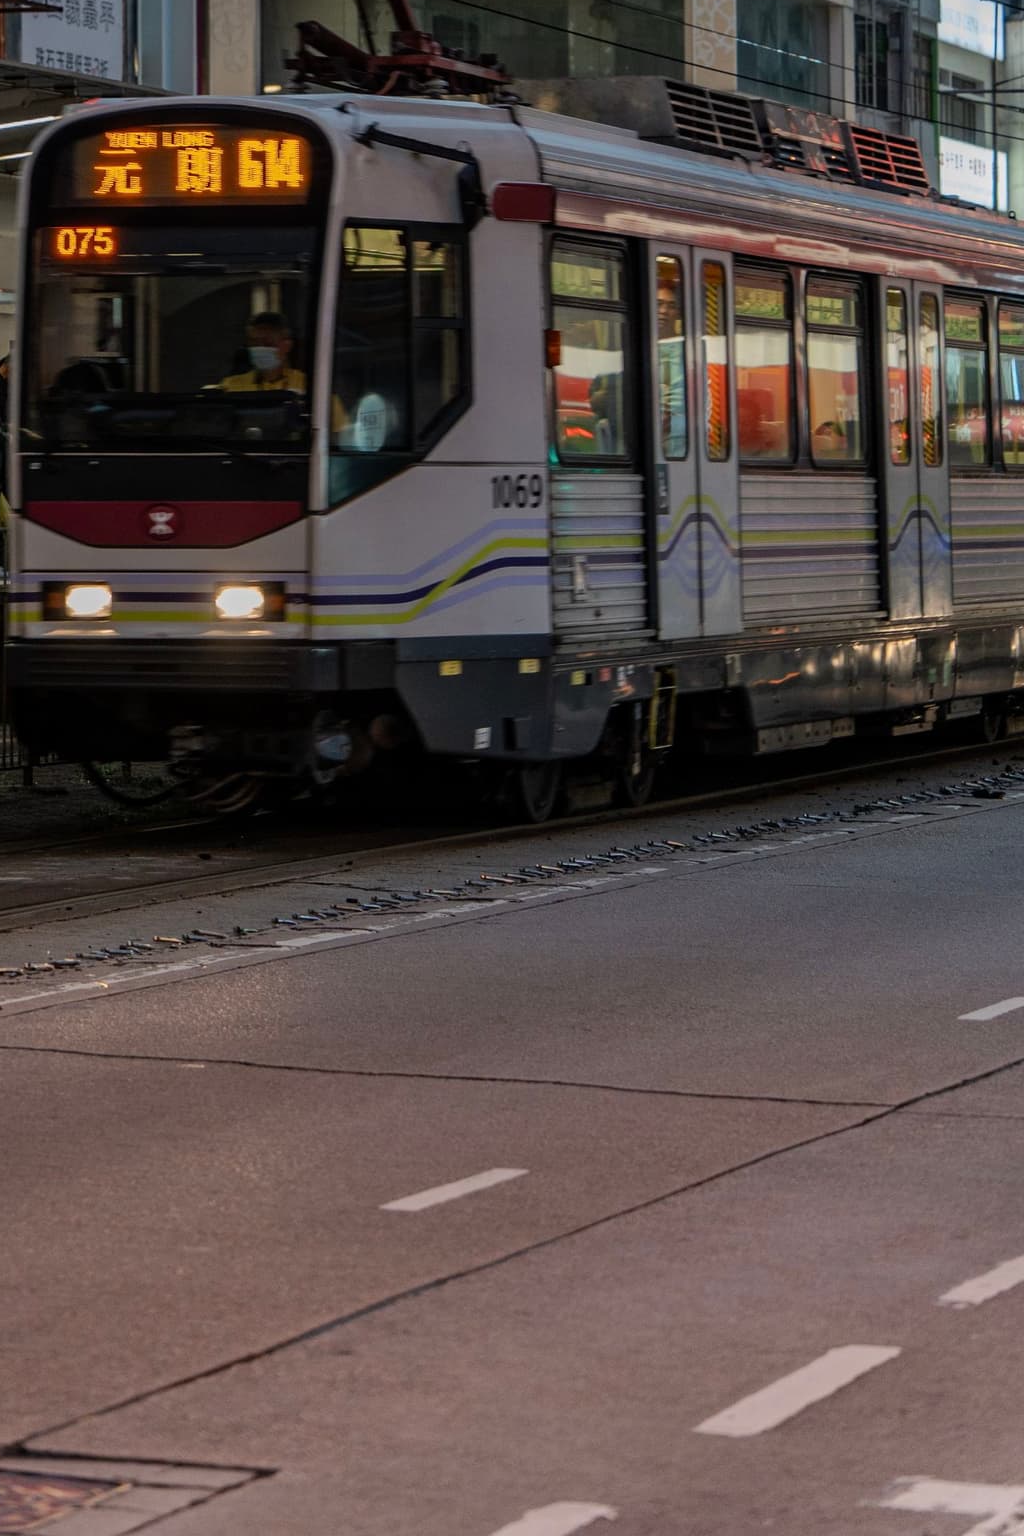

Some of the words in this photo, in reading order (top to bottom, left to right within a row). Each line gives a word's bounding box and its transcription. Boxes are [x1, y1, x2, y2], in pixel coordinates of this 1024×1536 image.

[238, 139, 304, 188] 614
[56, 228, 114, 256] 075
[491, 474, 543, 509] 1069
